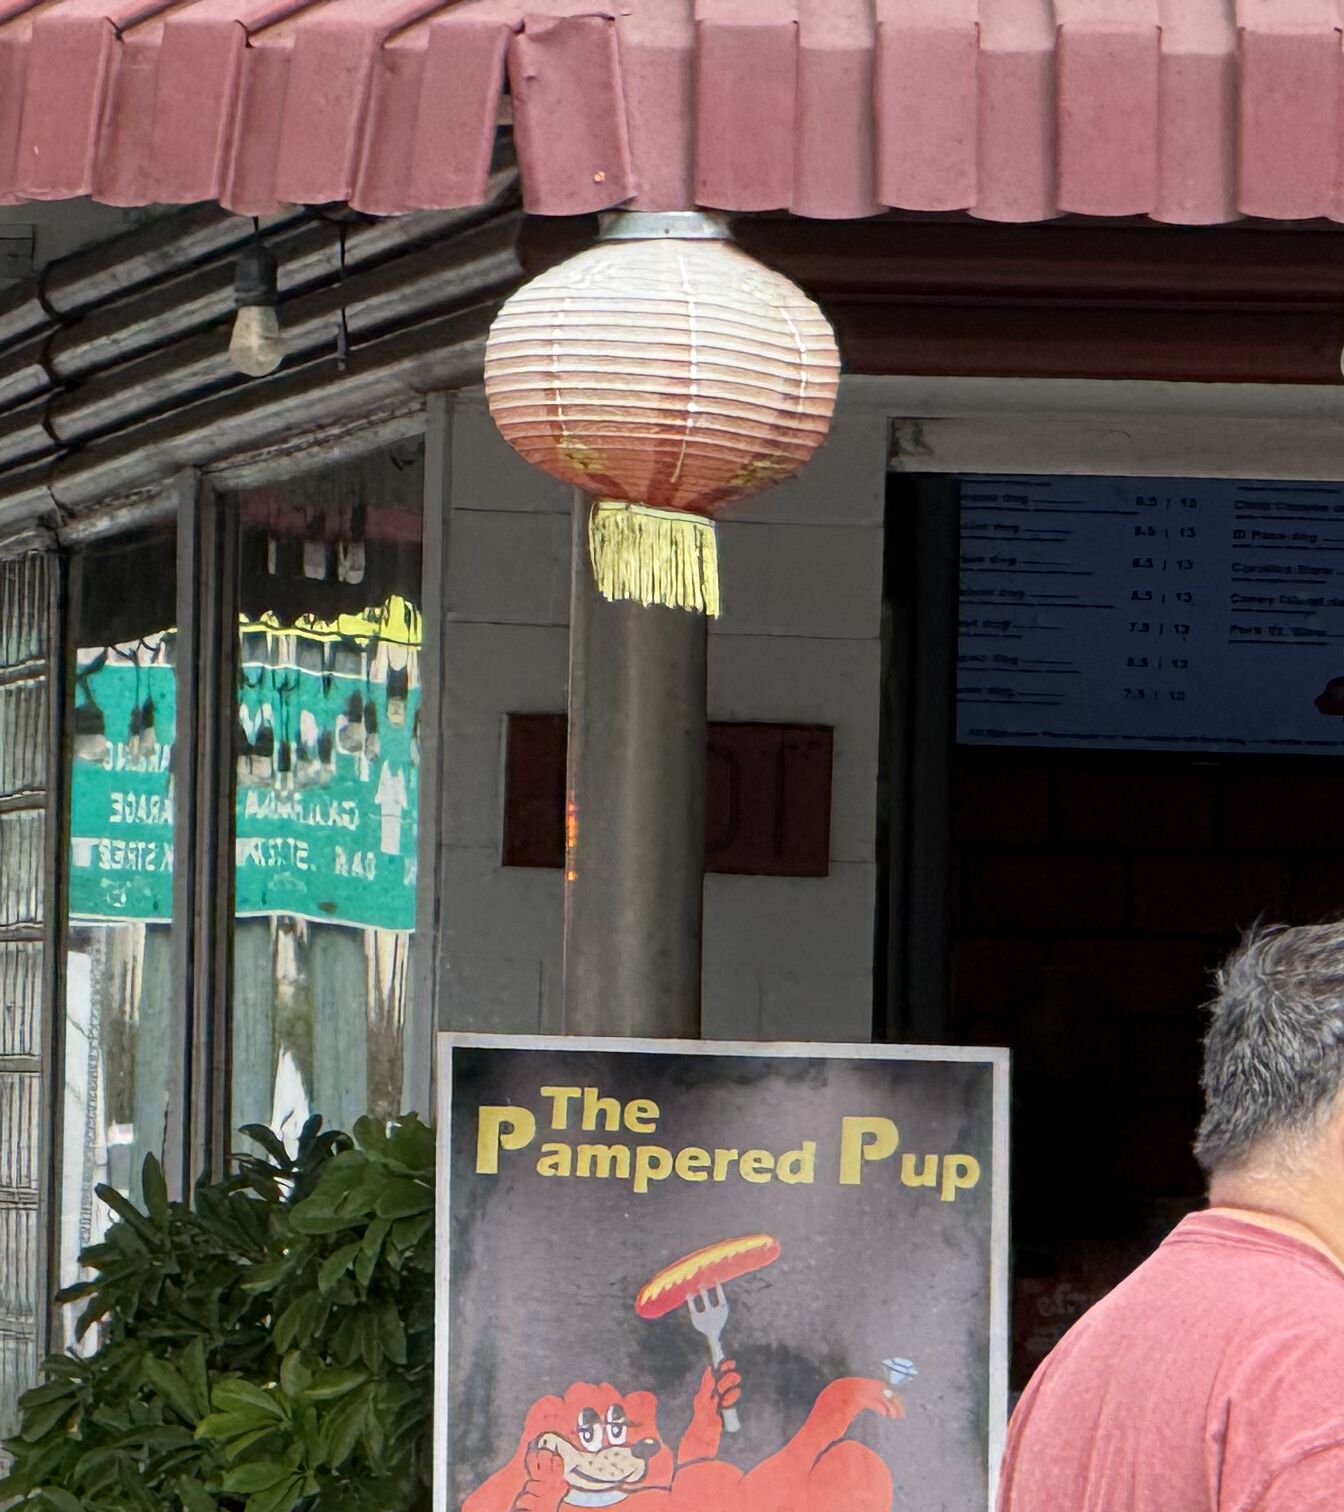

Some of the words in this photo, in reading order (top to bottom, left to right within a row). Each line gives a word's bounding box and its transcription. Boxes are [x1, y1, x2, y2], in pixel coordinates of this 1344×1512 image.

[540, 1086, 660, 1133] The
[475, 1105, 816, 1193] Pampered
[839, 1116, 981, 1202] Pup
